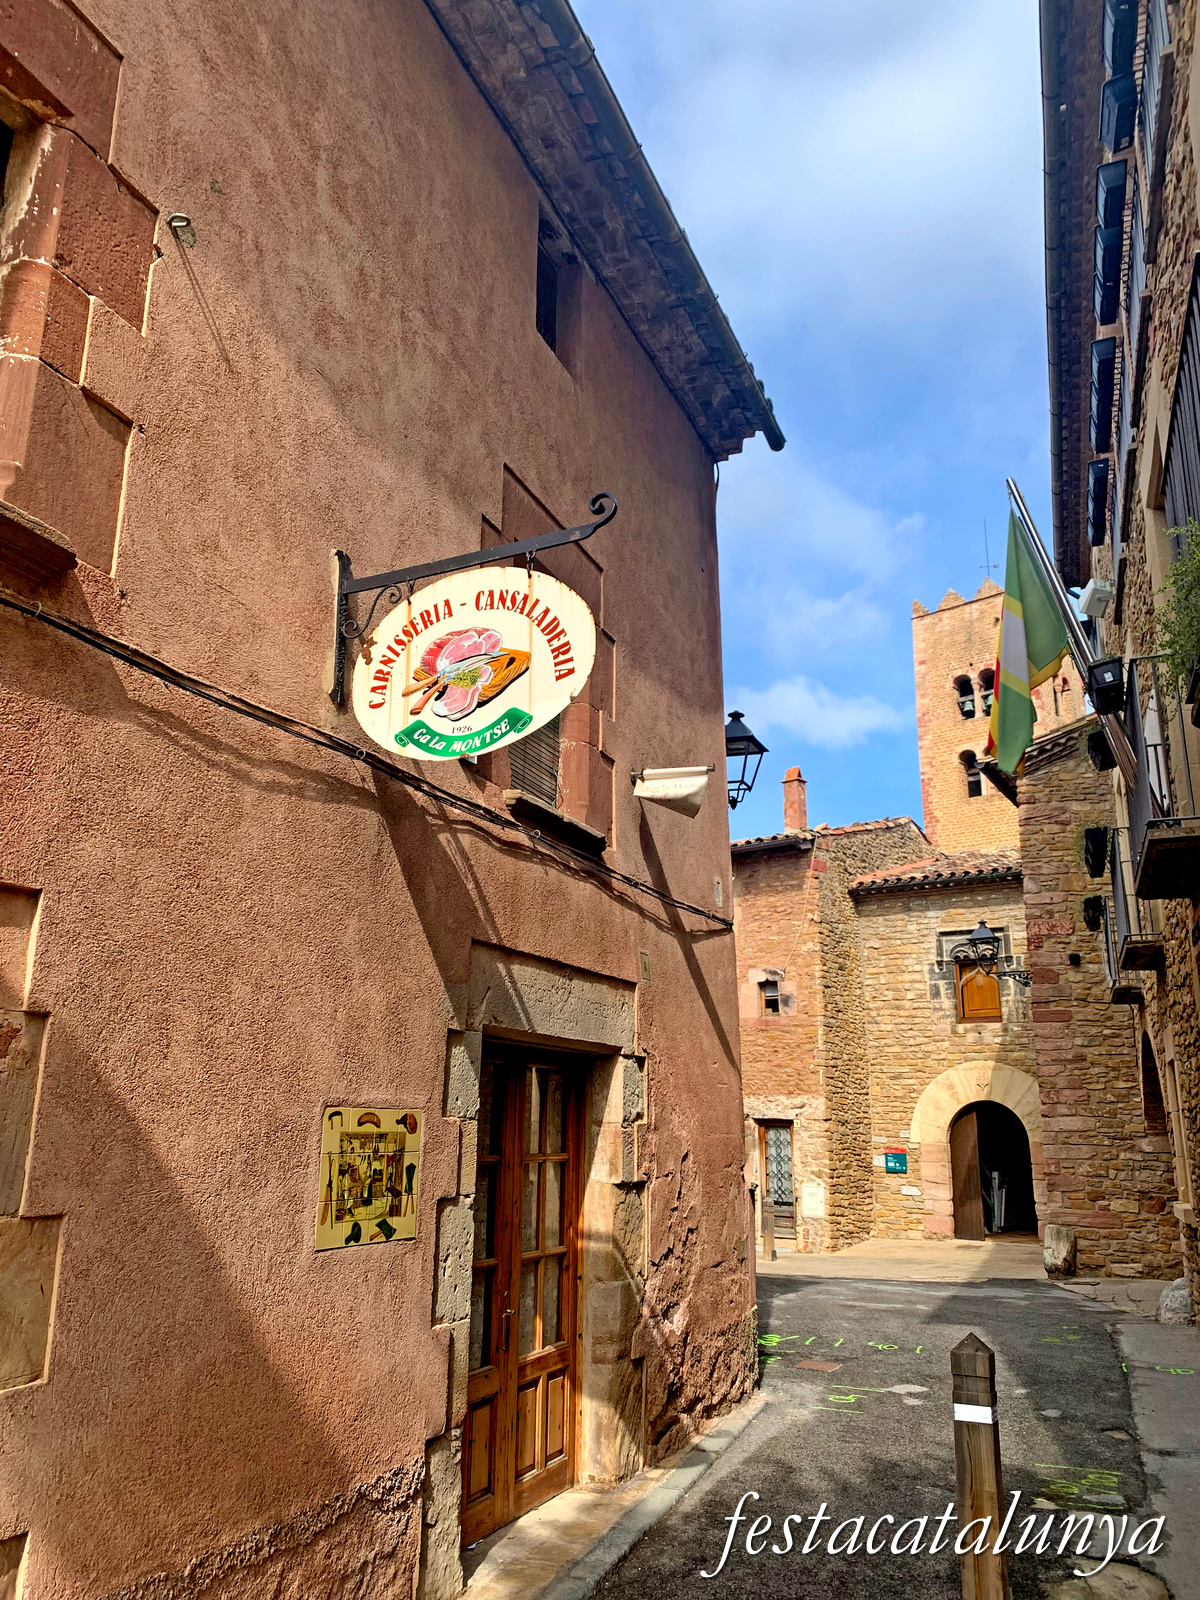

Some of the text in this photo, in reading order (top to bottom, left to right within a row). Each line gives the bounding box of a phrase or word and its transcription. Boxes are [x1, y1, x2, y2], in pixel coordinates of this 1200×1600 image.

[368, 598, 454, 709] CARNISSERIA
[474, 589, 576, 682] CANSALADERIA
[448, 718, 510, 753] MONTSE
[451, 725, 473, 734] 1926
